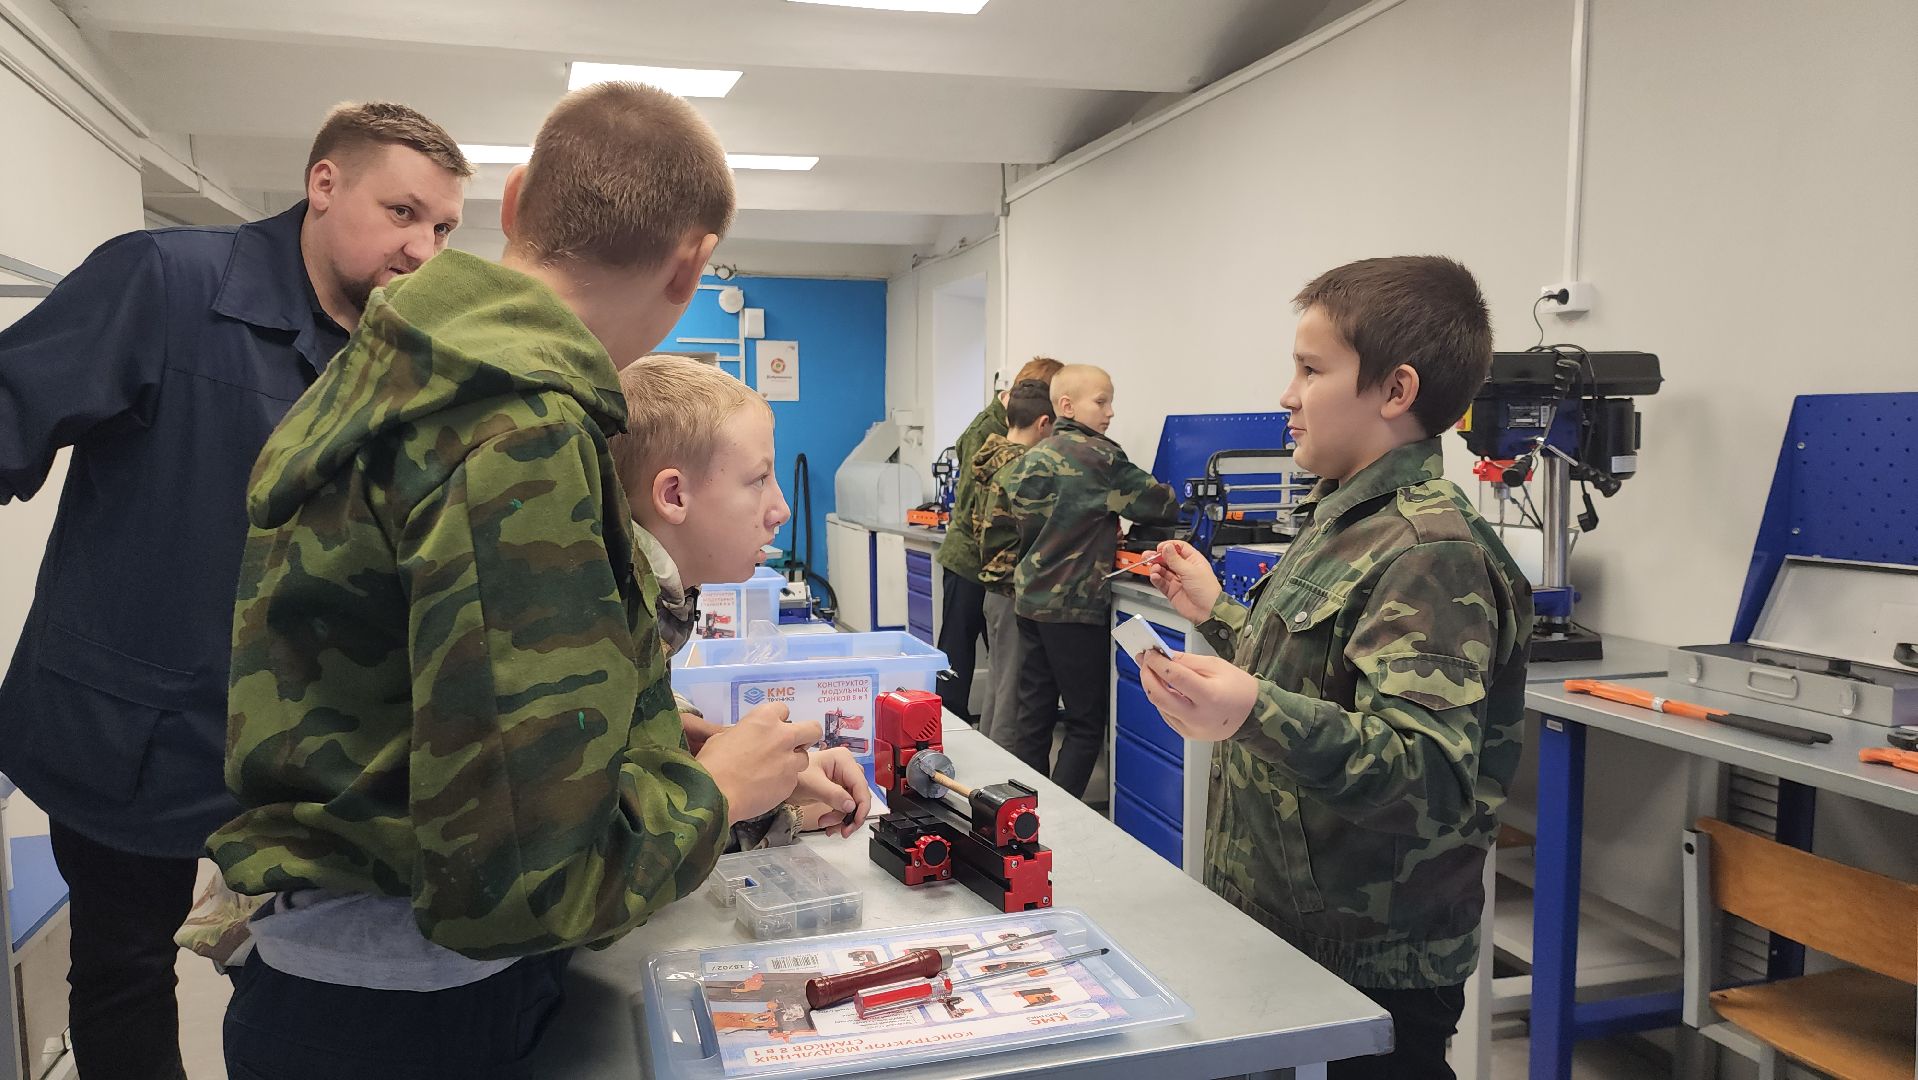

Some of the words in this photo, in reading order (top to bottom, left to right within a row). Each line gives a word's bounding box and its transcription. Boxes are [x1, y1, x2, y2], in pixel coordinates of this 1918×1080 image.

[817, 680, 869, 689] КОНСТРУКТОР
[767, 687, 796, 698] КМС
[821, 687, 869, 696] МОДУЛЬНЫХ
[817, 695, 851, 704] СТАНКОВ
[1029, 1014, 1069, 1026] КМС
[793, 1038, 864, 1052] СТАНКОВ
[865, 1031, 974, 1050] КОНСТРУКТОР
[754, 1045, 860, 1063] МОДУЛЬНЫХ
